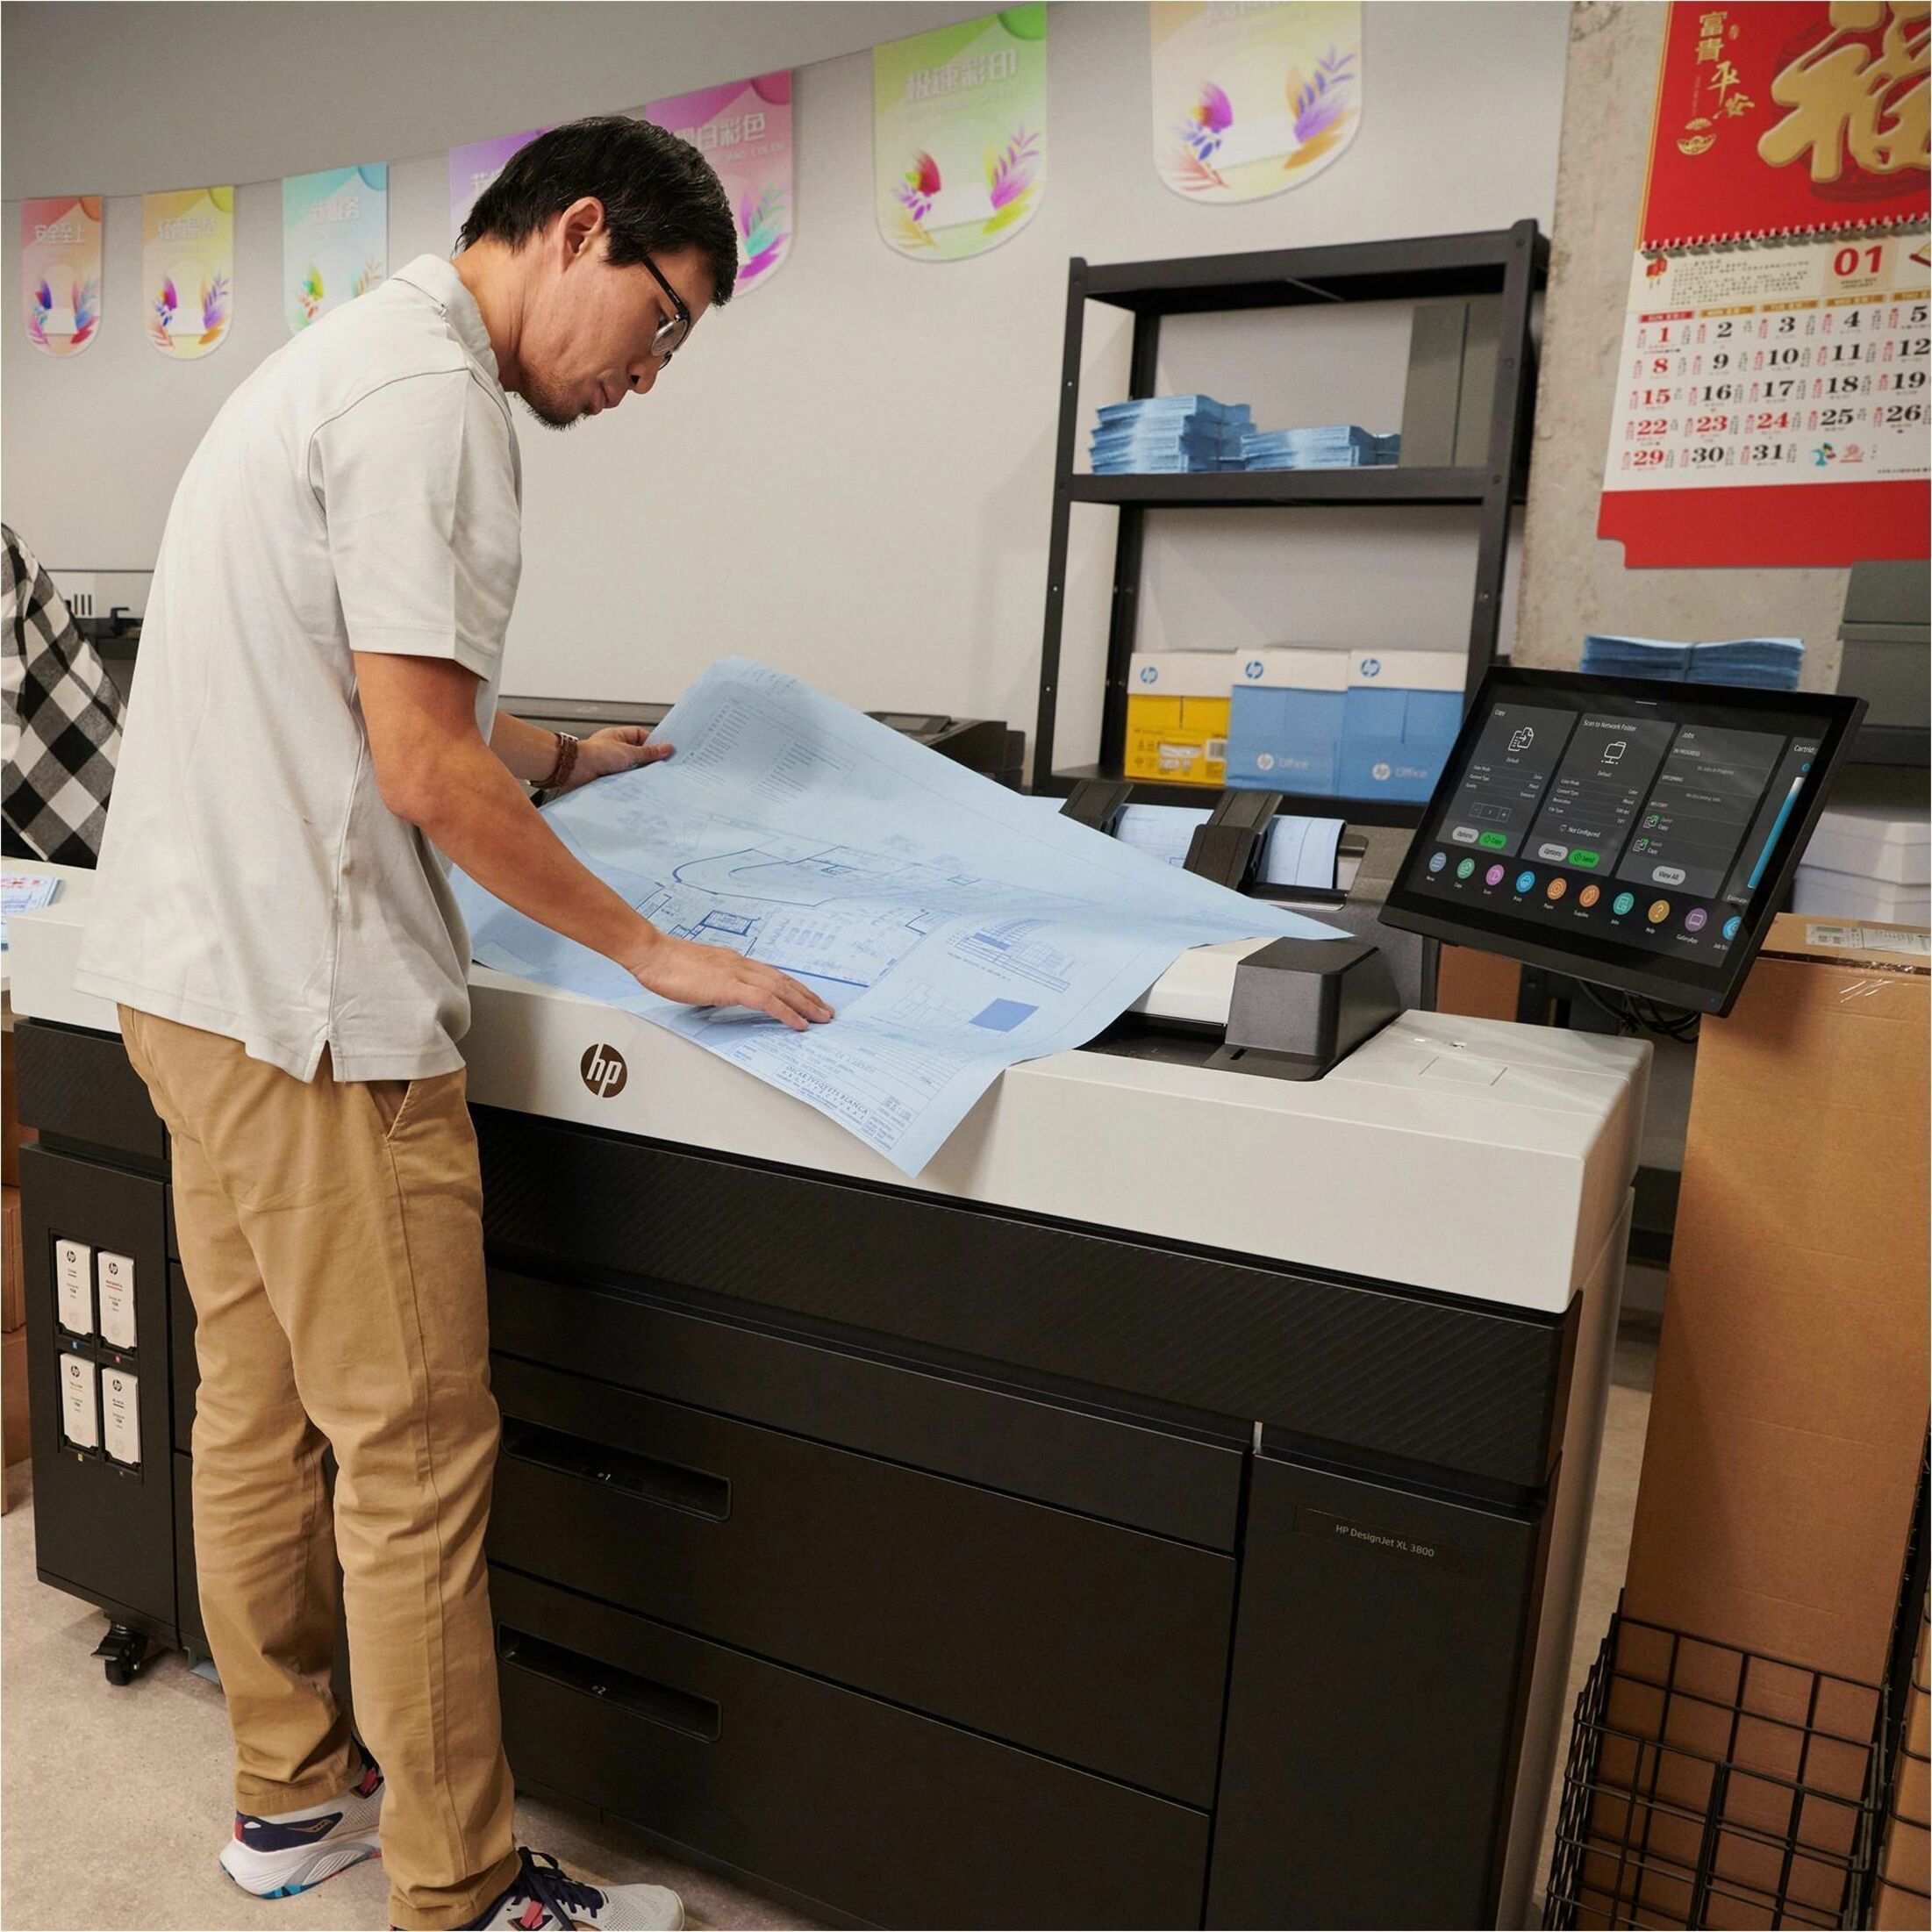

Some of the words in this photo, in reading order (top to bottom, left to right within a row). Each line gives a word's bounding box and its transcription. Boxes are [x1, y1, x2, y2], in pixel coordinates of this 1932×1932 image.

[1834, 246, 1882, 276] 01
[1658, 327, 1668, 343] 1
[1717, 322, 1733, 339] 2
[1778, 317, 1795, 333] 3
[1844, 311, 1860, 327] 4
[1910, 305, 1928, 323] 5
[1653, 358, 1668, 374] 8
[1713, 354, 1728, 370] 9
[1767, 348, 1798, 366] 10
[1832, 343, 1861, 361] 11
[1896, 338, 1930, 356] 12
[1642, 390, 1671, 405] 15
[1701, 385, 1732, 402] 16
[1763, 381, 1794, 397] 17
[1827, 376, 1858, 394] 18
[1893, 371, 1926, 390] 19
[1637, 419, 1668, 435] 22
[1696, 416, 1728, 433] 23
[1757, 412, 1789, 430] 24
[1821, 409, 1854, 426] 25
[1886, 404, 1921, 423] 26
[1633, 450, 1664, 466] 29
[1692, 447, 1724, 463] 30
[1753, 444, 1783, 461] 31
[1494, 708, 1506, 717] Copy
[1601, 721, 1621, 730] Network
[1395, 767, 1428, 779] Office
[1543, 847, 1562, 857] Options
[1658, 869, 1671, 880] View
[581, 1043, 627, 1098] hp
[1335, 1525, 1349, 1535] HP
[1350, 1528, 1394, 1547] DesignJet
[1396, 1539, 1407, 1550] XL
[1411, 1544, 1435, 1557] 3800
